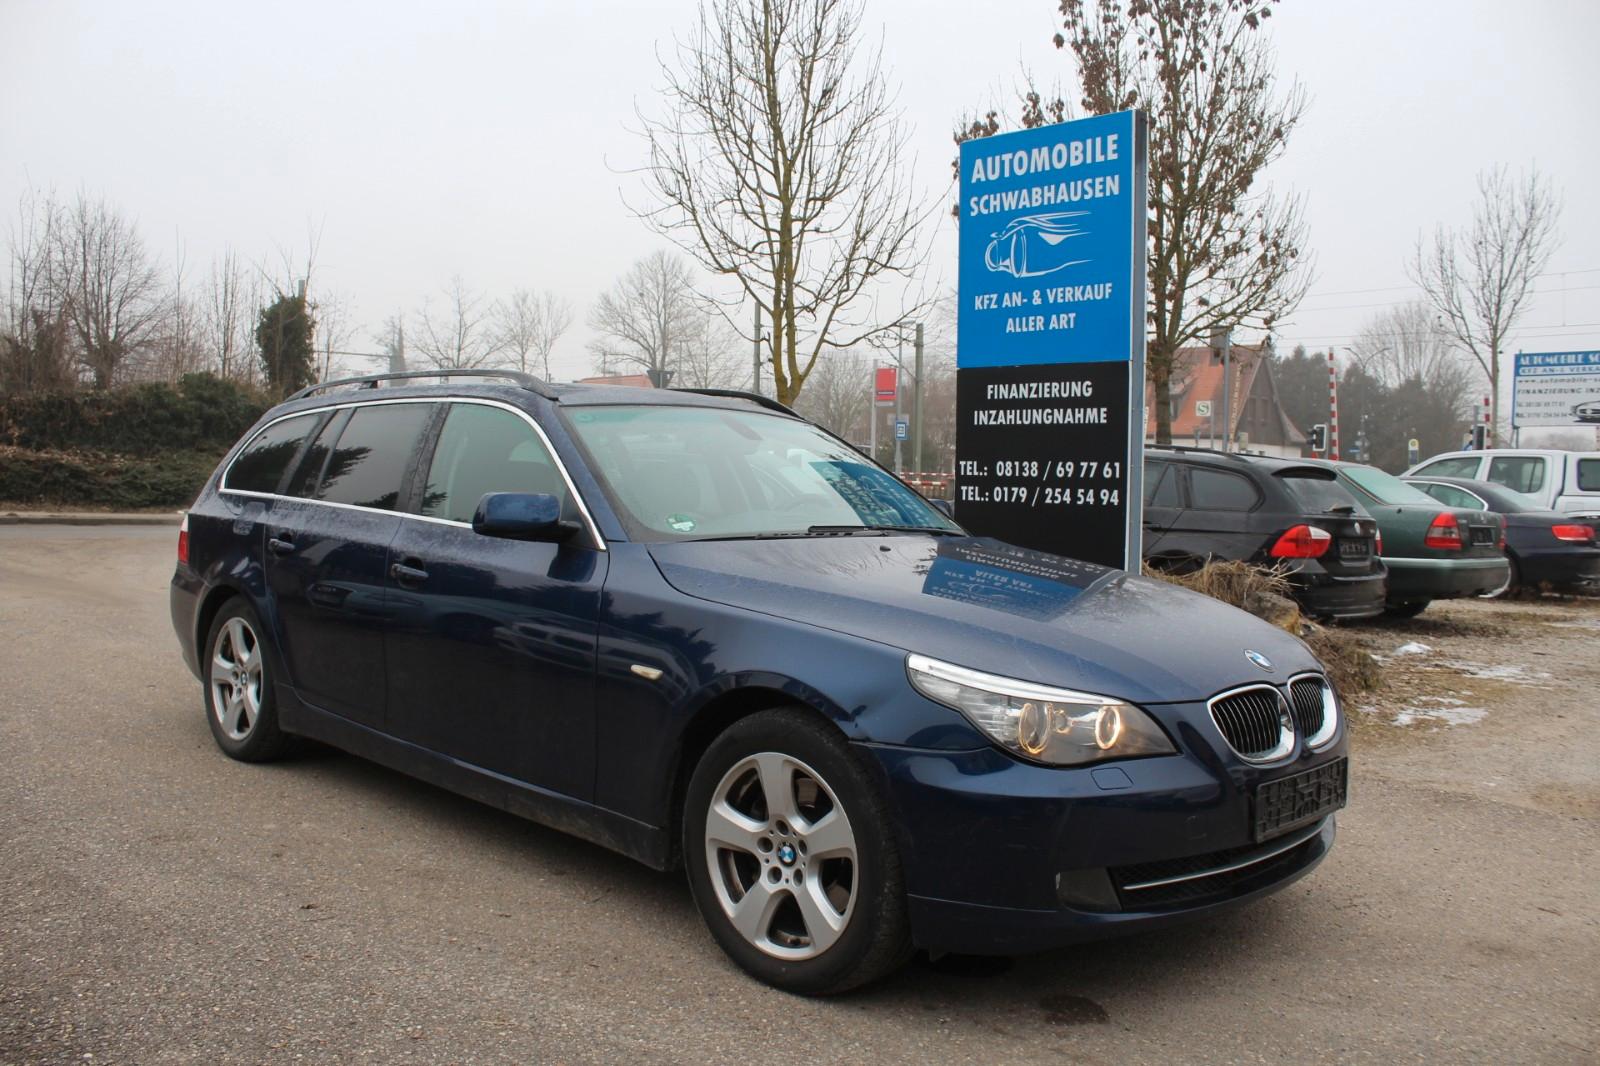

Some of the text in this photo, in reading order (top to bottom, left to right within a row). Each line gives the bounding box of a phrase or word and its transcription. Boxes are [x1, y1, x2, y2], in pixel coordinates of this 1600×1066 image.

[970, 133, 1119, 184] AUTOMOBILE
[969, 174, 1120, 217] SCHWABHAUSEN
[974, 282, 1113, 311] KFZ AN- & VERKAUF
[1005, 312, 1076, 333] ALLER ART
[986, 380, 1093, 400] FINANZIERUNG
[973, 407, 1108, 426] INZAHLUNGNAHME
[959, 460, 1120, 481] TEL.: 08138 / 69 77 61
[960, 485, 1120, 507] TEL.: 0179 / 254 54 94
